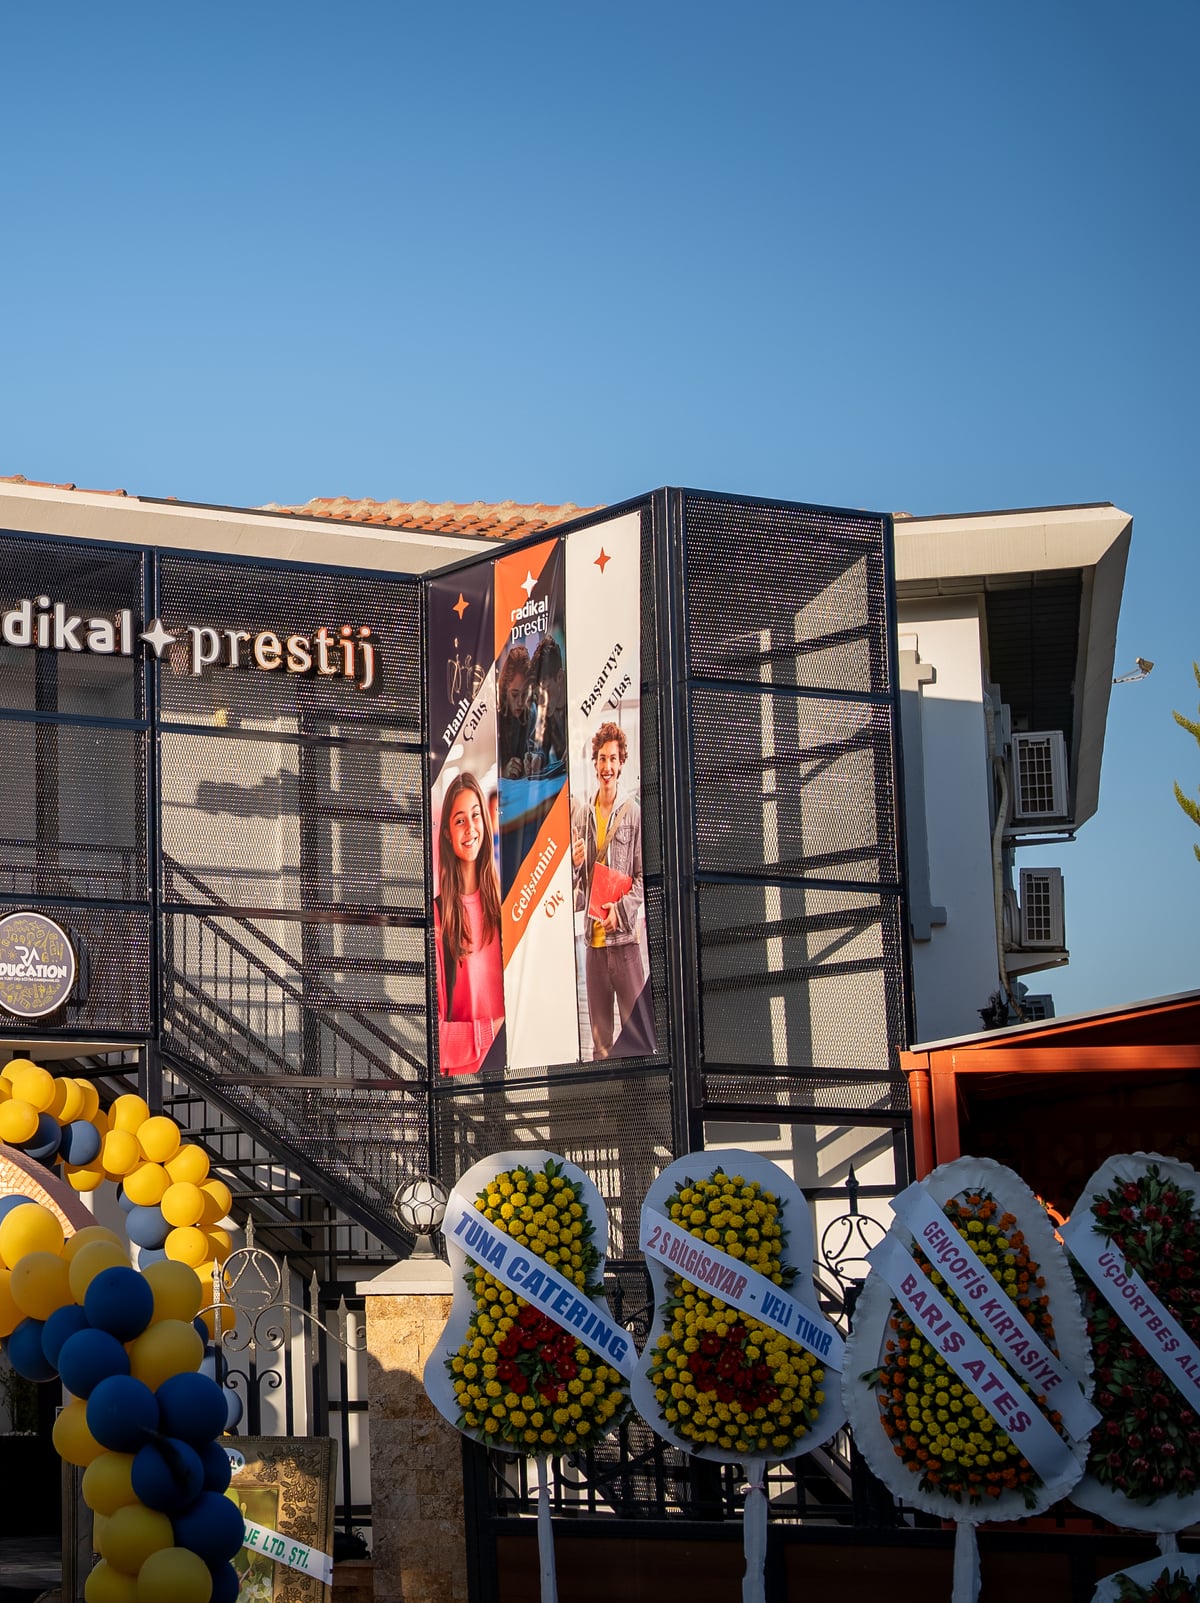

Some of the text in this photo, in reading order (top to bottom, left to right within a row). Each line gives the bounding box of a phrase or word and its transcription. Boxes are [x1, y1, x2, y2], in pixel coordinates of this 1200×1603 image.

[511, 595, 549, 622] radikal
[511, 612, 549, 644] prestij
[187, 624, 375, 690] prestij
[579, 642, 623, 718] Başarıya
[442, 698, 470, 748] Planlı
[463, 701, 487, 742] Çalış
[608, 672, 632, 710] Ulaş
[511, 837, 558, 922] Gelişimini
[545, 890, 564, 919] Ölç
[454, 1211, 628, 1363] TUNA CATERING
[668, 1239, 748, 1300] BİLGİSAYAR
[760, 1291, 793, 1328] VELİ
[795, 1314, 833, 1356] TIKIR
[922, 1221, 1063, 1392] GENÇOFİS KIRTASİYE
[1098, 1252, 1180, 1353] ÜÇDÖRTBEŞ
[900, 1273, 1032, 1433] BARIŞ ATEŞ
[262, 1535, 286, 1559] LTD.
[288, 1546, 310, 1569] ŞTİ.
